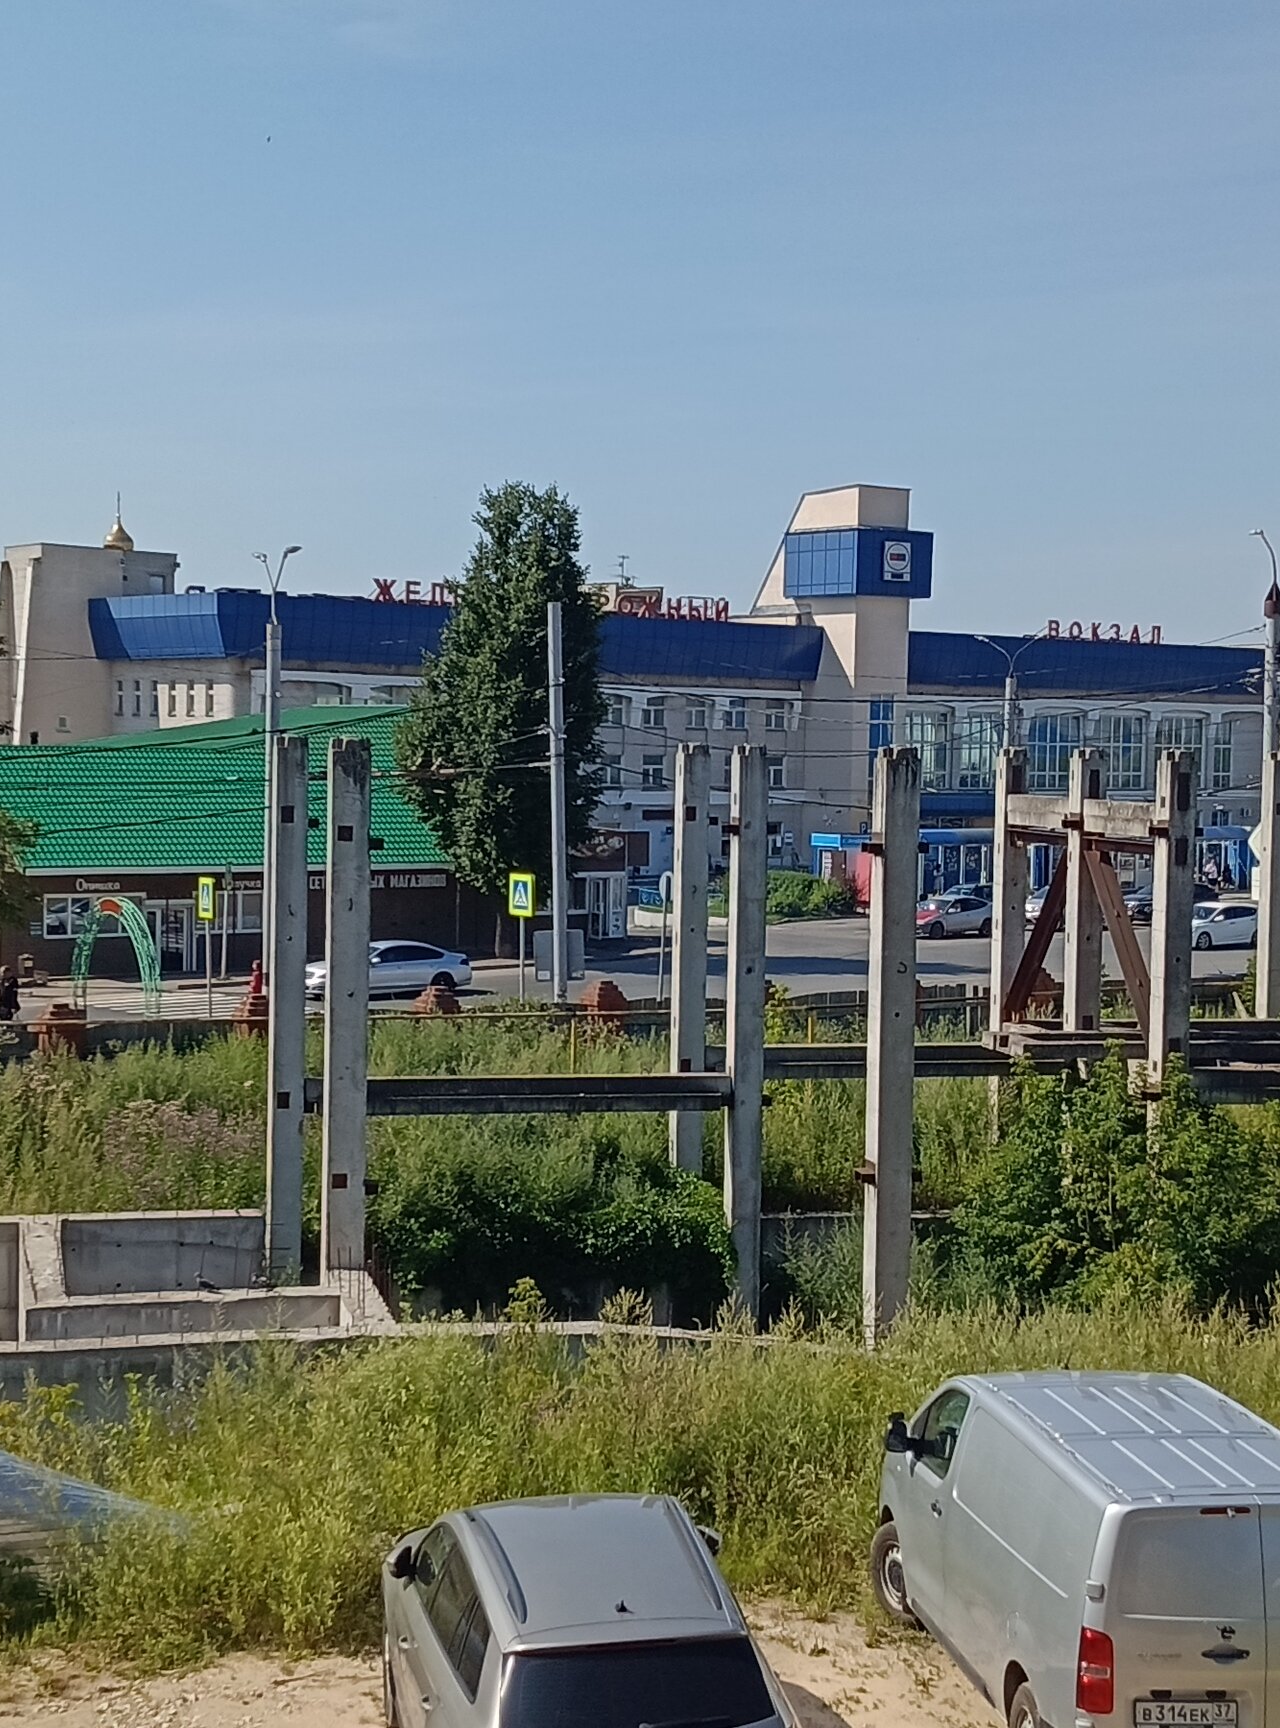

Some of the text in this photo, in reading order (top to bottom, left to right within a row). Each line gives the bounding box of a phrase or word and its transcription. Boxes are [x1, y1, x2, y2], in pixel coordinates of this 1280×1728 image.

[1047, 619, 1161, 645] ВОКЗАЛ
[1142, 1703, 1231, 1722] В314ЕК 37
